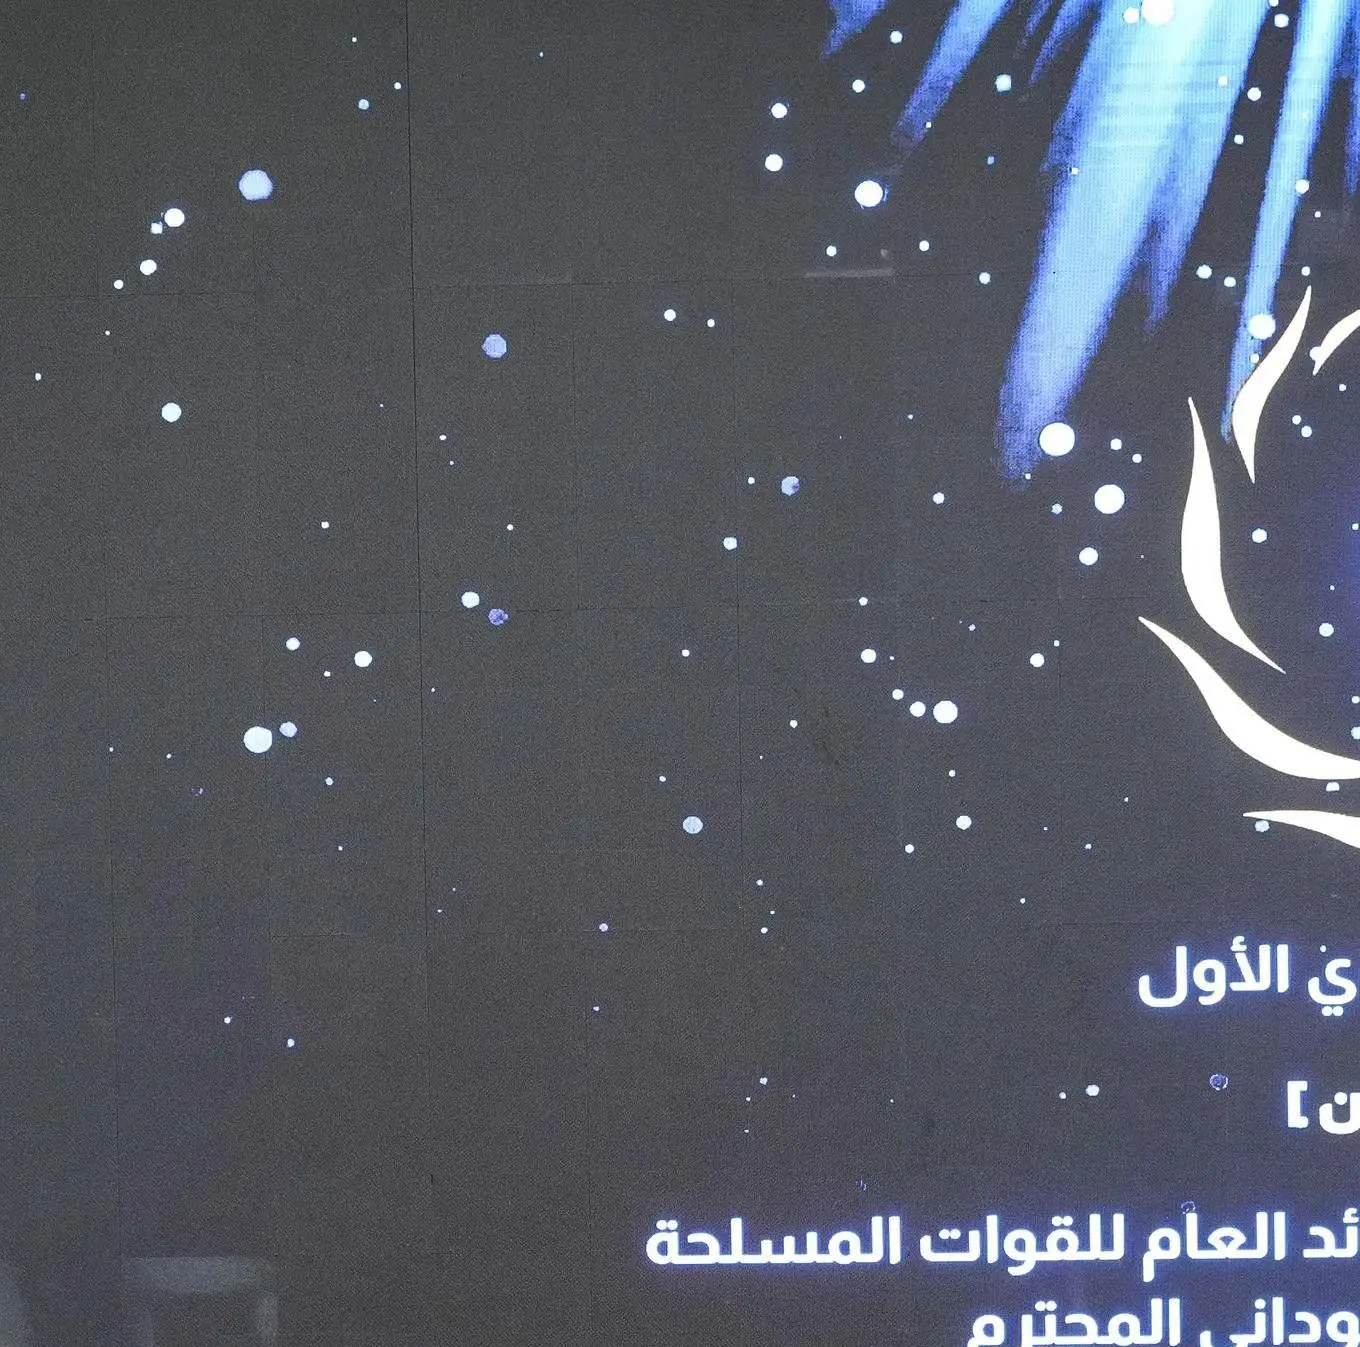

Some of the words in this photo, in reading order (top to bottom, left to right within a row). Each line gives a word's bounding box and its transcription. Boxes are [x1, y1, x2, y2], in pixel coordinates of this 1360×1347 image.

[1138, 935, 1290, 1008] الأول
[645, 1215, 902, 1265] المسلحة
[919, 1212, 1125, 1277] للقوات
[1142, 1211, 1286, 1283] العام
